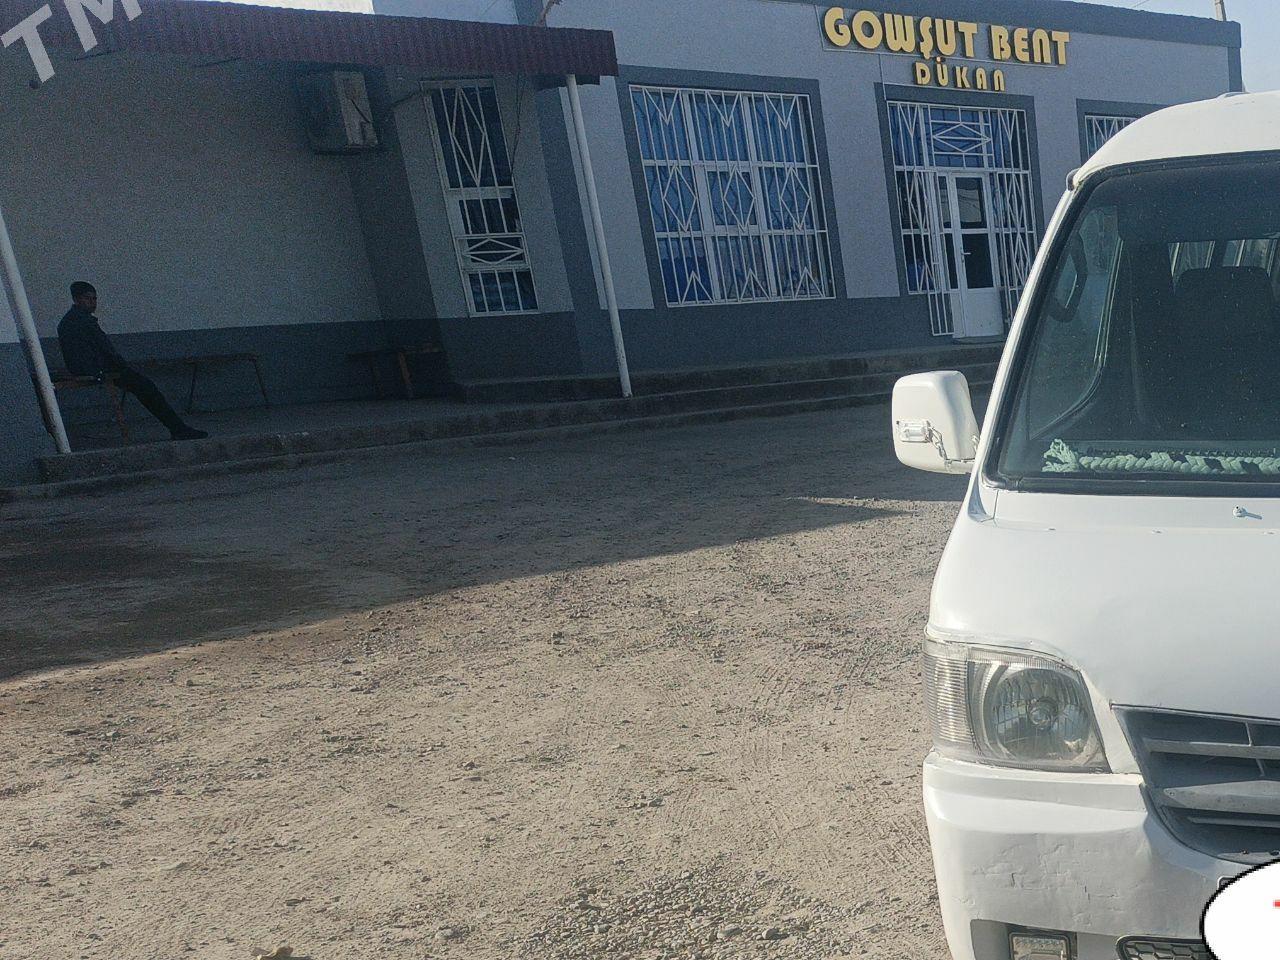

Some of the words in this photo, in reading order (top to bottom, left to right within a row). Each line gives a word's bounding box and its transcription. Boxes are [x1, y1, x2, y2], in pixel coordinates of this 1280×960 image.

[824, 7, 978, 60] GOWŞUT
[989, 25, 1070, 65] BENT
[915, 57, 1005, 91] DÜKAN
